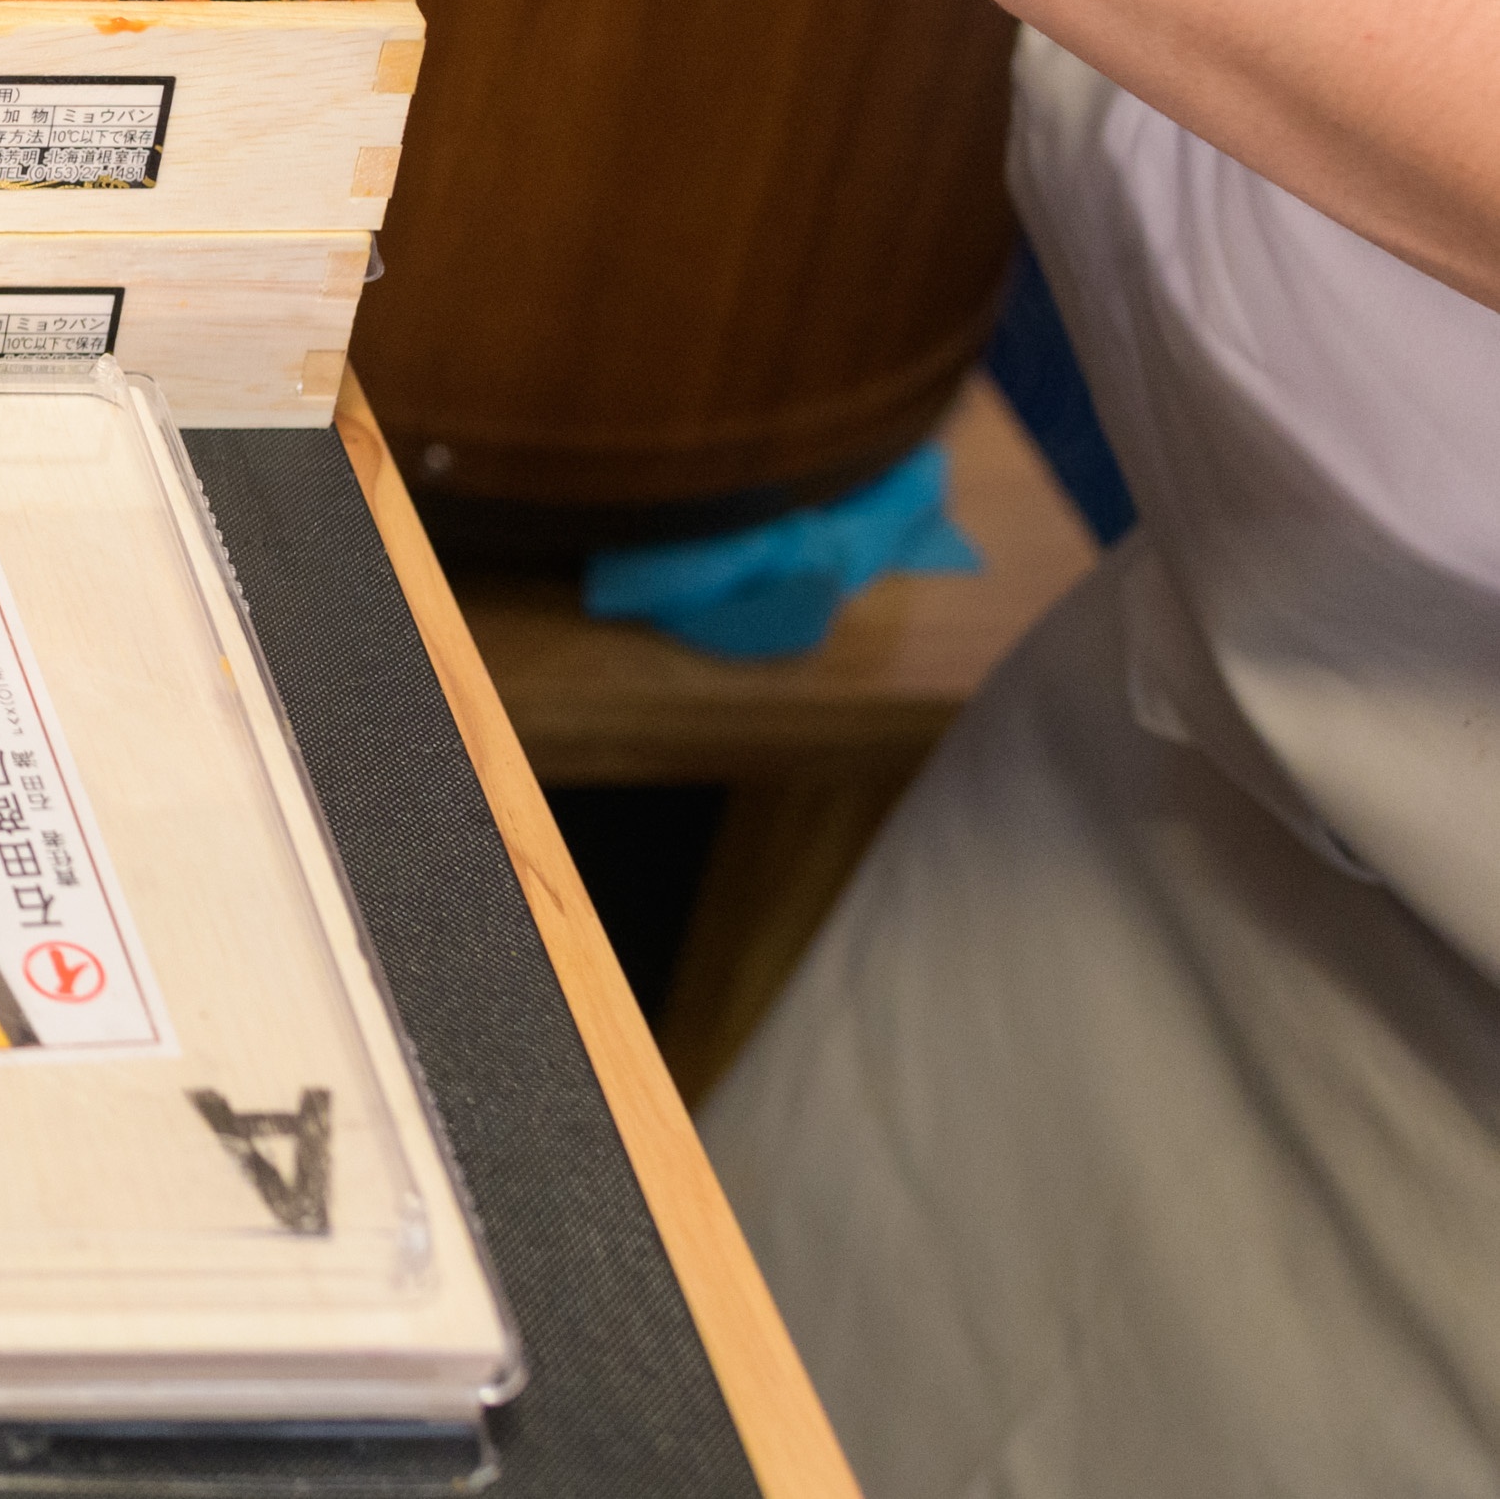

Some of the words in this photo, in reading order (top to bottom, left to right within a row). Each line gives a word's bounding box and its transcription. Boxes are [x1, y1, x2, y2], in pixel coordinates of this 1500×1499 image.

[64, 108, 154, 123] ミョウバン
[43, 149, 148, 164] 北海道根室市
[16, 318, 105, 332] ミョウバン
[183, 1087, 333, 1237] A
